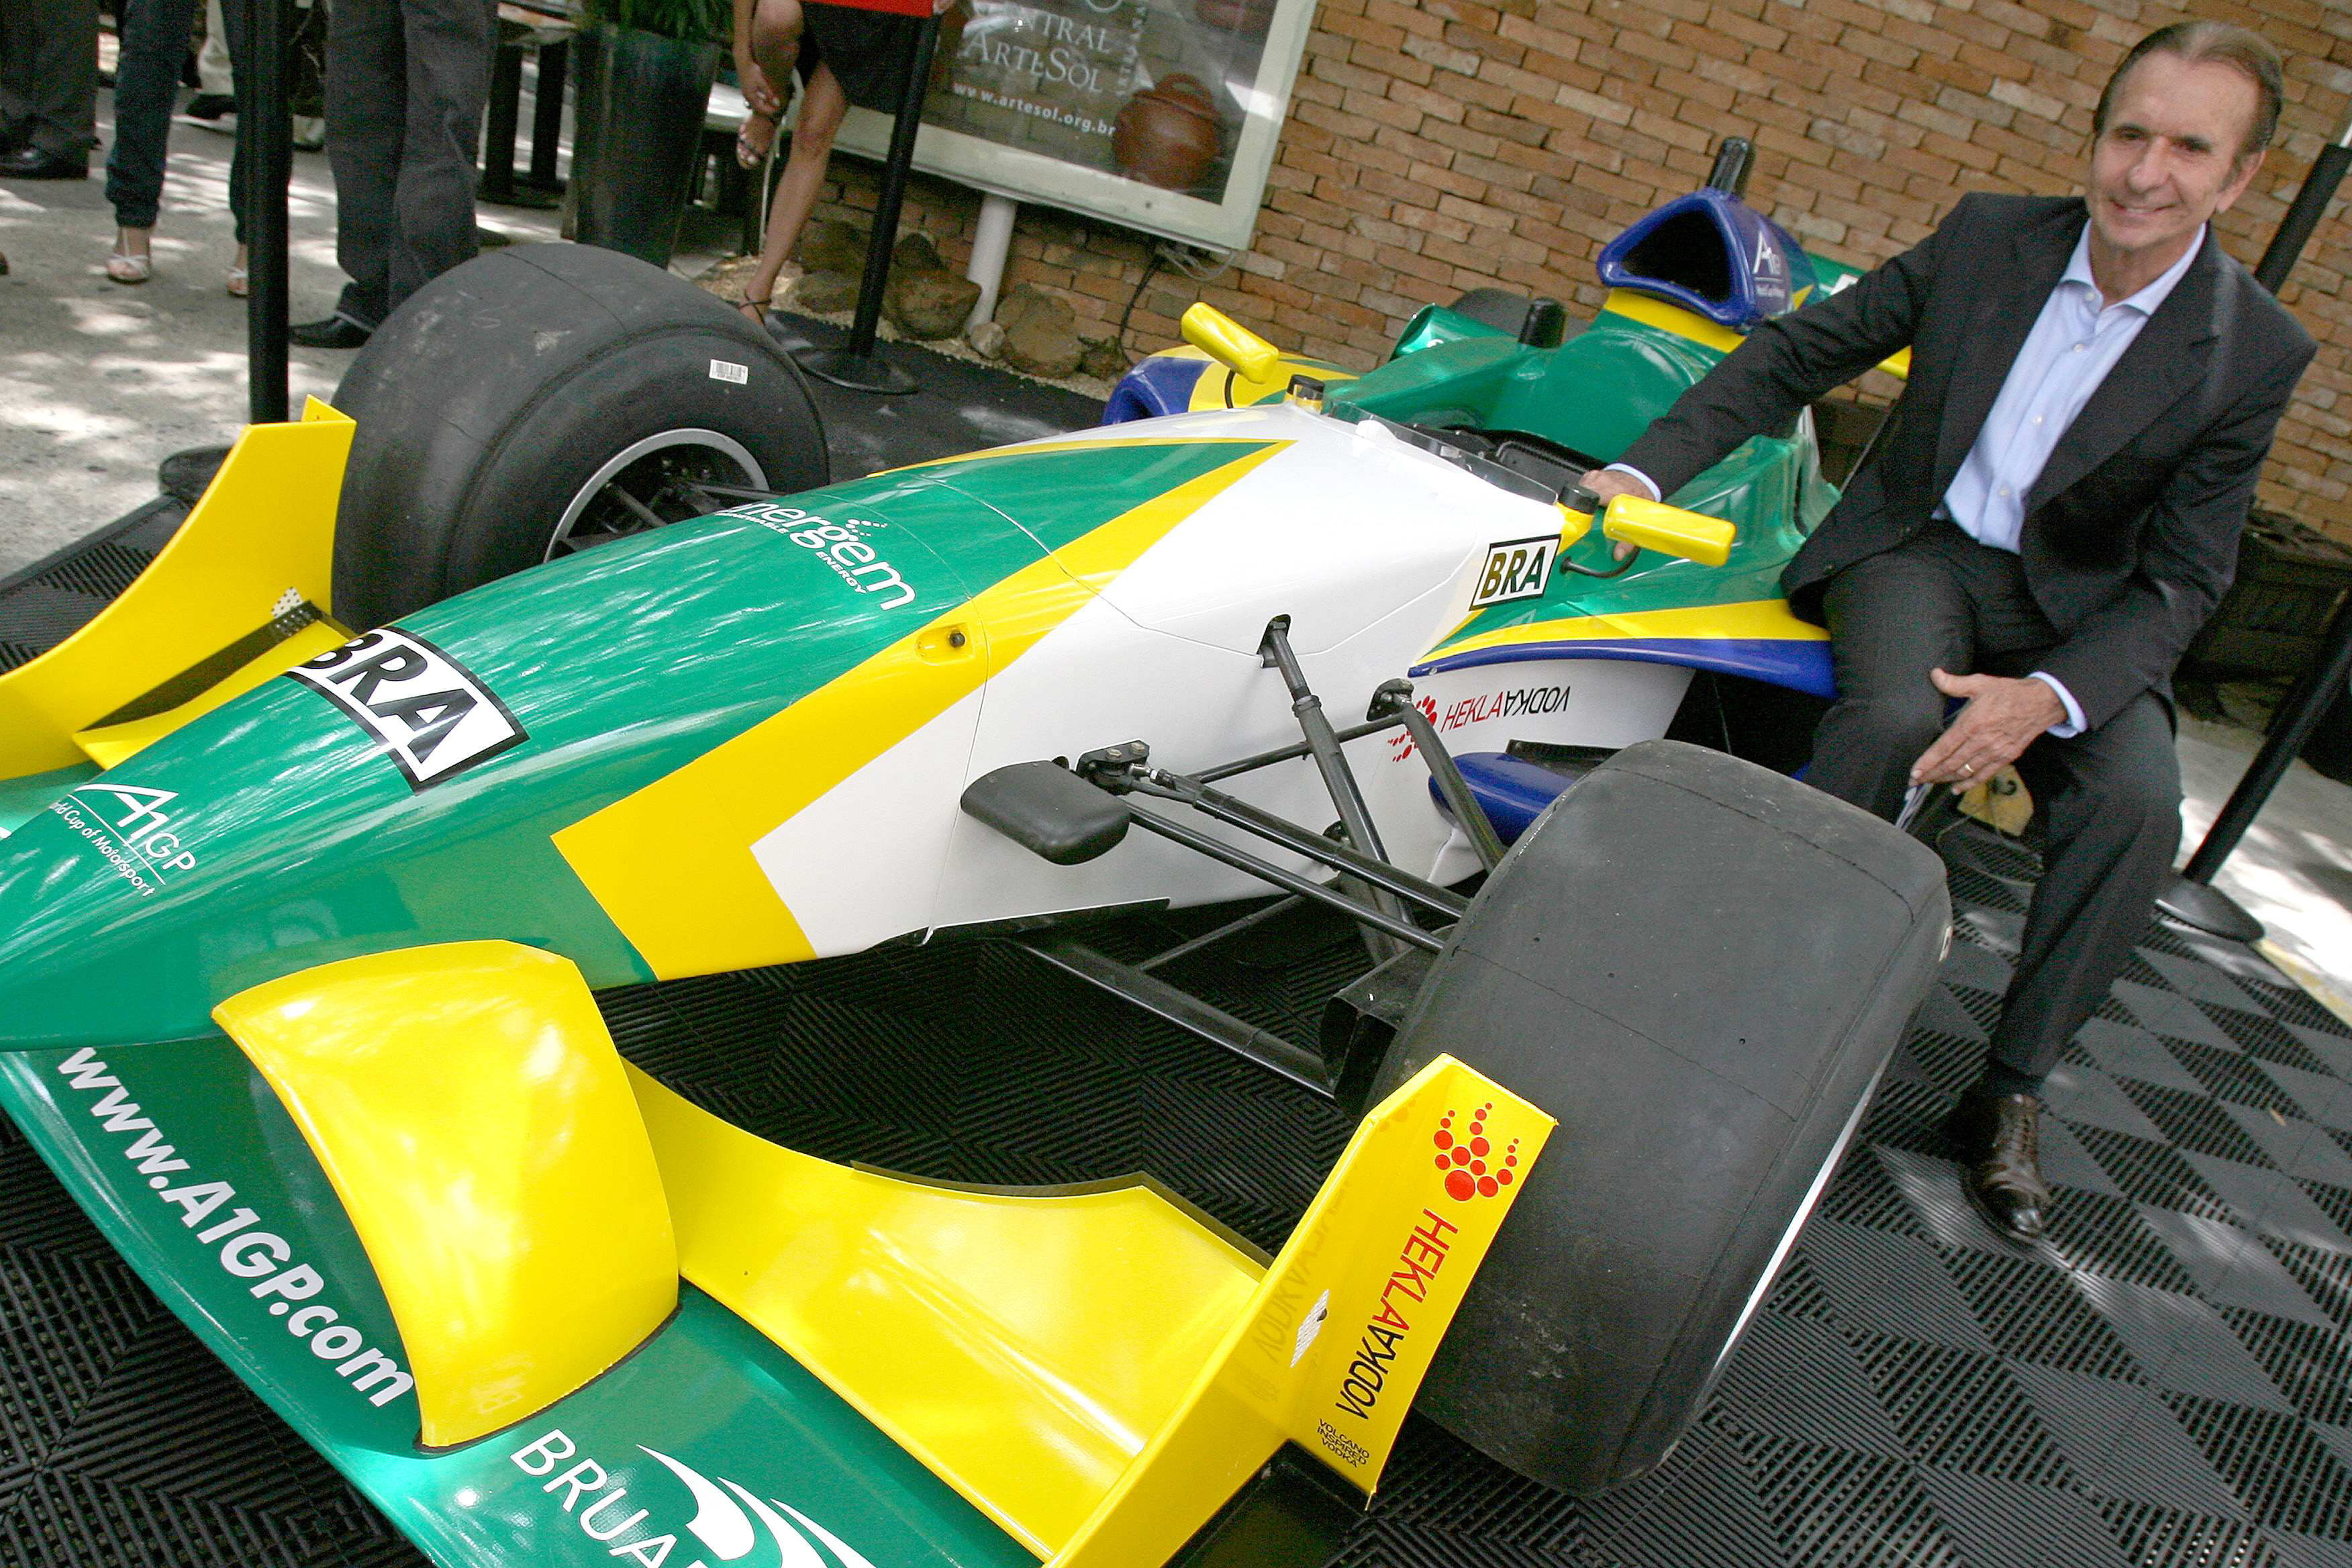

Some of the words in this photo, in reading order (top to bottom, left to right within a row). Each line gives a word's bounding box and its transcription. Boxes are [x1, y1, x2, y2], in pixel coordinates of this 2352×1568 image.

[952, 82, 1118, 136] www.artesol.org.br
[816, 551, 867, 594] ENERGY
[1479, 546, 1546, 599] BRA
[297, 633, 478, 764] BRA
[1440, 691, 1504, 733] HEKLA
[1504, 686, 1571, 717] VODKA
[64, 810, 86, 829] Cup
[74, 783, 197, 871] A1GP
[81, 828, 102, 838] of
[91, 835, 156, 897] Motorsport
[58, 1047, 414, 1408] www.A1GP.com
[1372, 1208, 1459, 1332] HEKLA
[1335, 1323, 1405, 1420] VODKA
[1317, 1426, 1367, 1465] INSPIRED
[1319, 1418, 1370, 1459] VOLCANO
[1322, 1438, 1357, 1468] VODKA
[510, 1428, 708, 1568] BRUA
